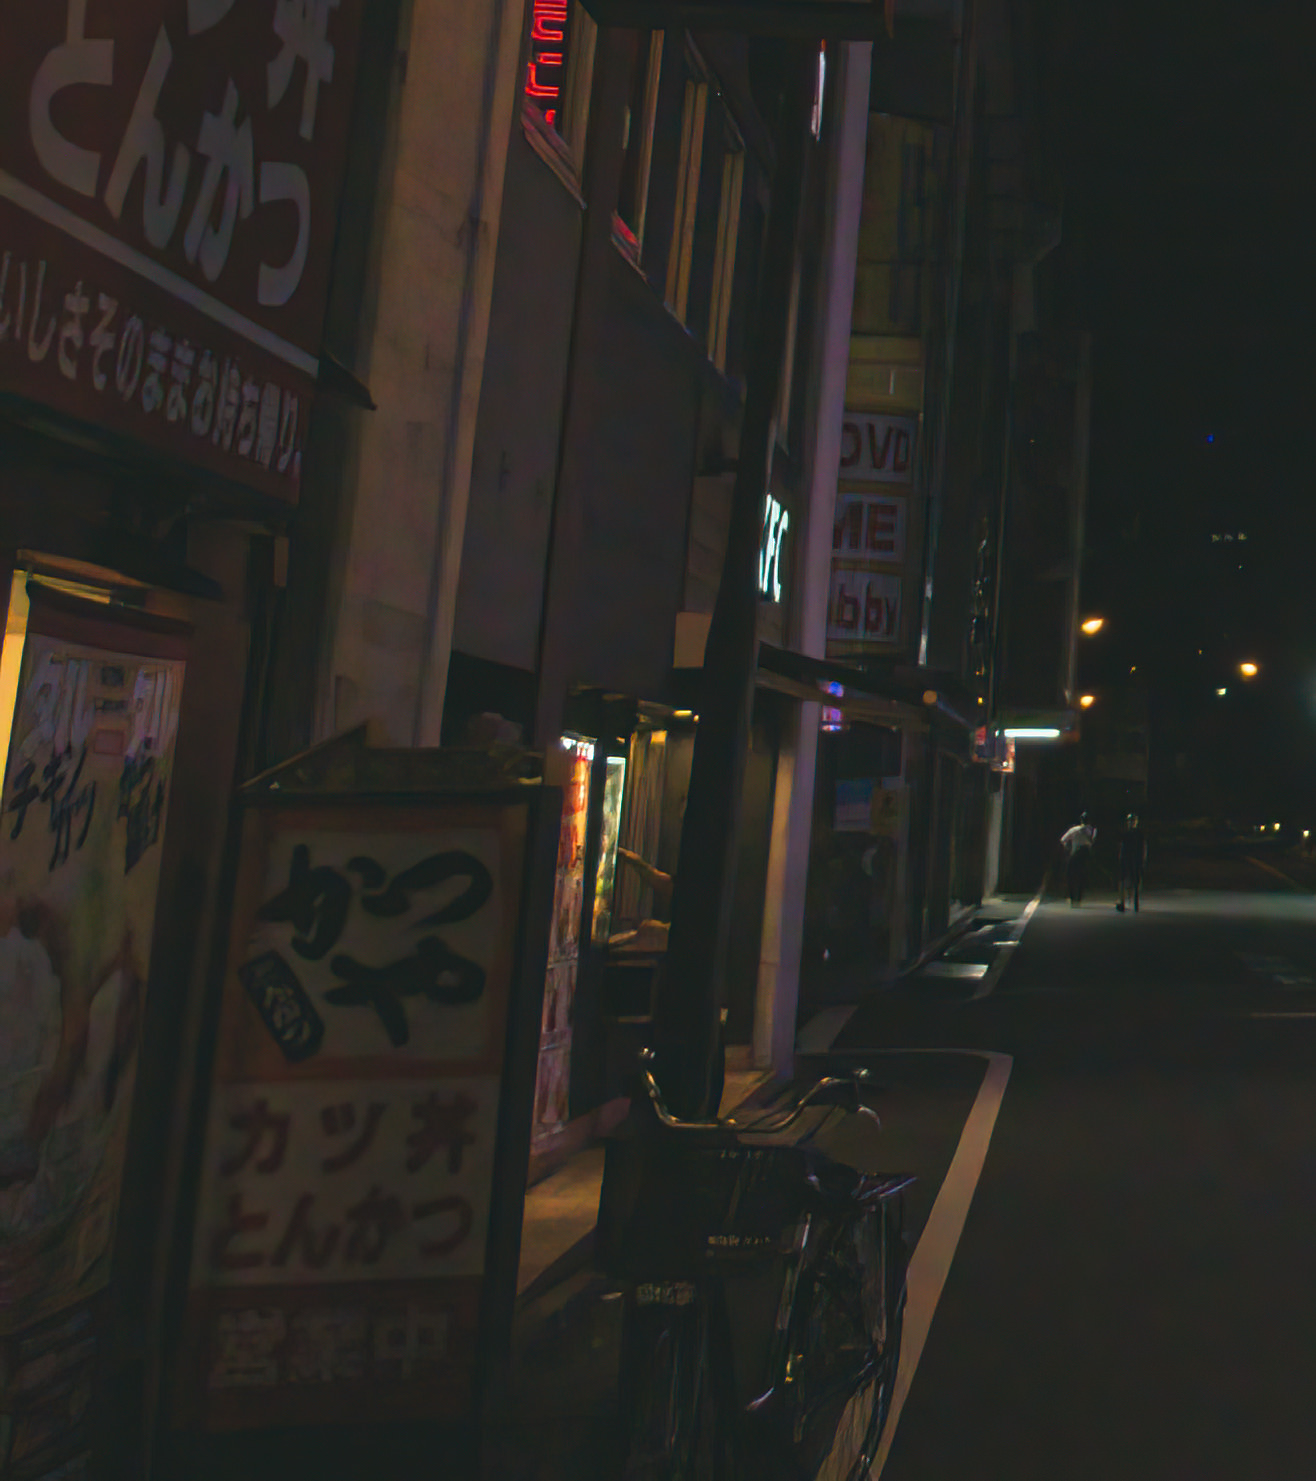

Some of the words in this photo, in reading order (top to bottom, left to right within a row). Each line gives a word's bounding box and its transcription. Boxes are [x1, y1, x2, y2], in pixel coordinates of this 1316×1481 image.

[220, 1090, 479, 1179] カツ丼
[209, 1184, 474, 1271] とんかつ
[207, 1302, 450, 1390] 営業中
